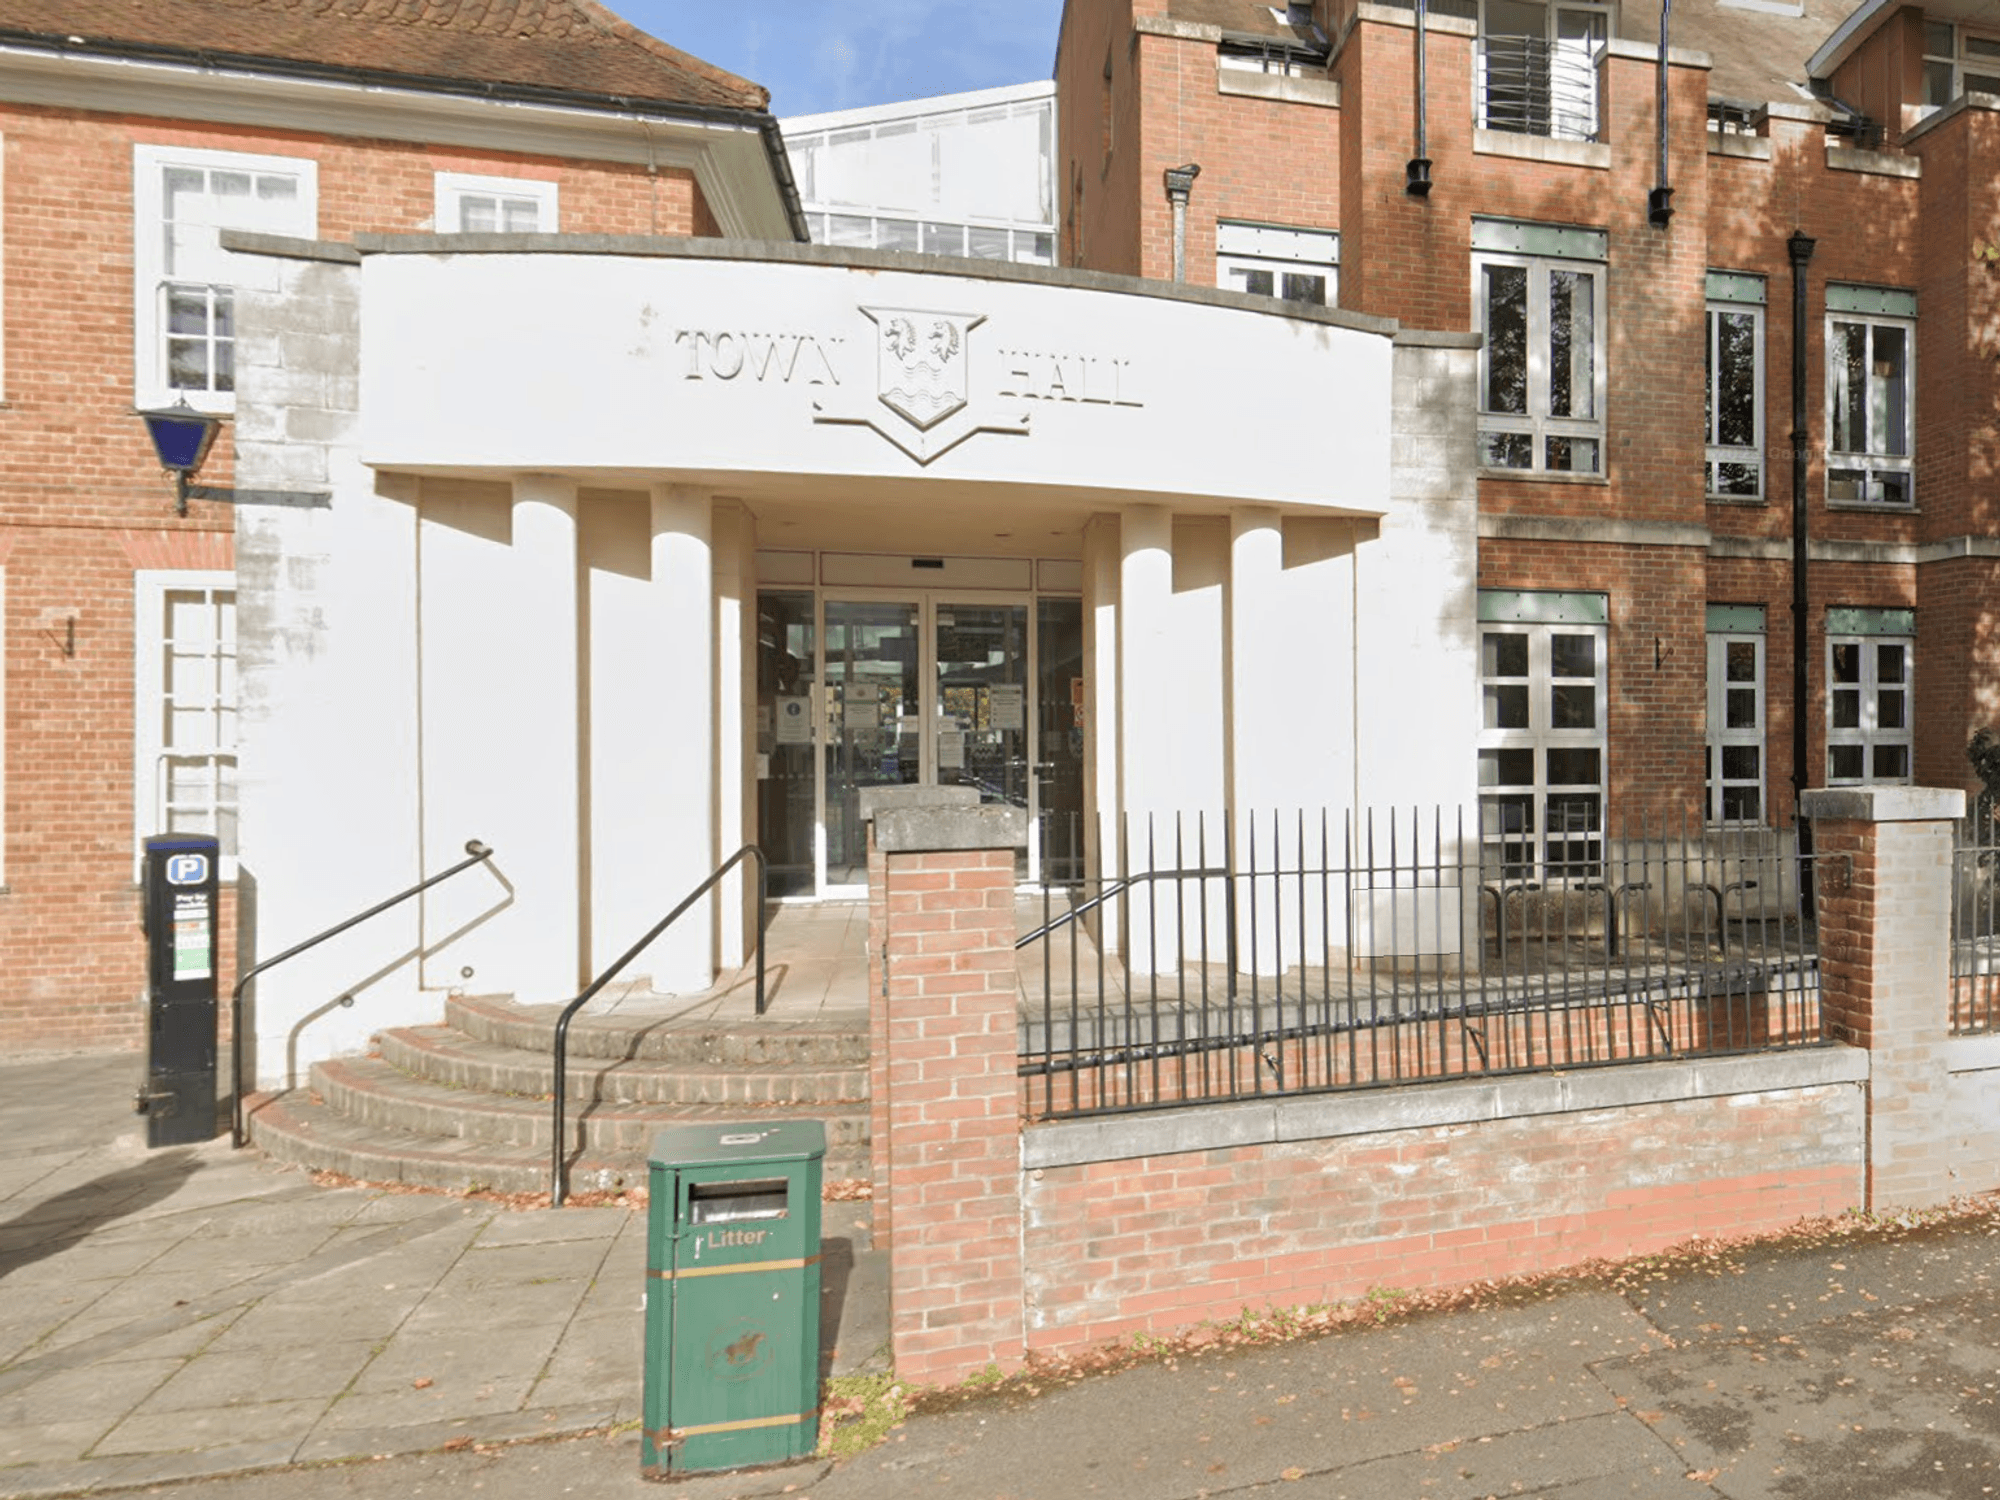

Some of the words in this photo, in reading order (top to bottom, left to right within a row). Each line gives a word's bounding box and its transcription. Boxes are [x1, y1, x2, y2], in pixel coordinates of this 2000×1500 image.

[675, 330, 845, 386] TOWN
[998, 349, 1144, 408] HALL
[178, 858, 199, 880] P
[707, 1230, 766, 1250] Litter
